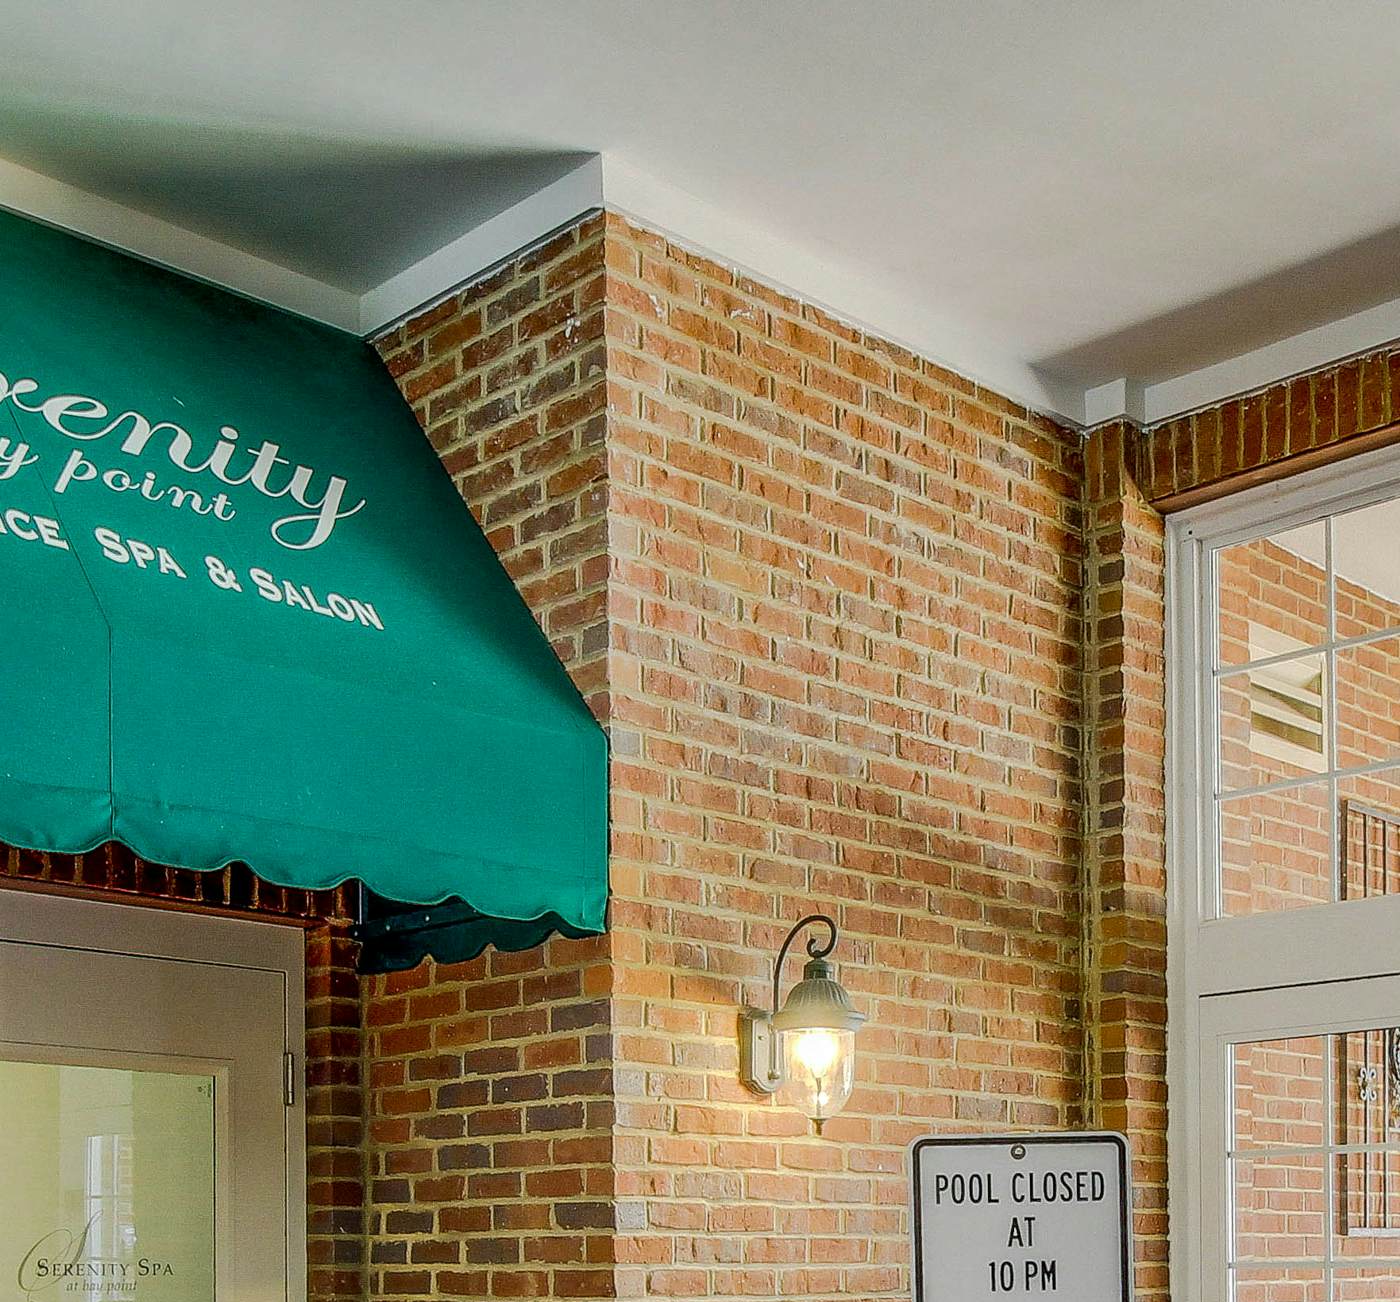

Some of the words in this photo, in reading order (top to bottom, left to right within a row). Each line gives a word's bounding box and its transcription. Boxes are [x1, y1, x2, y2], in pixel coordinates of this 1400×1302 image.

[53, 449, 237, 521] point
[0, 508, 70, 551] CE
[94, 527, 188, 579] SPA
[204, 555, 243, 593] &
[248, 567, 385, 631] SALON
[936, 1173, 999, 1204] POOL
[1012, 1171, 1105, 1203] CLOSED
[1007, 1216, 1036, 1248] AT
[36, 1258, 130, 1278] SERENITY
[138, 1258, 175, 1277] SPA
[988, 1260, 1014, 1292] 10
[1025, 1260, 1057, 1291] PM
[66, 1282, 78, 1292] at
[106, 1278, 138, 1296] point
